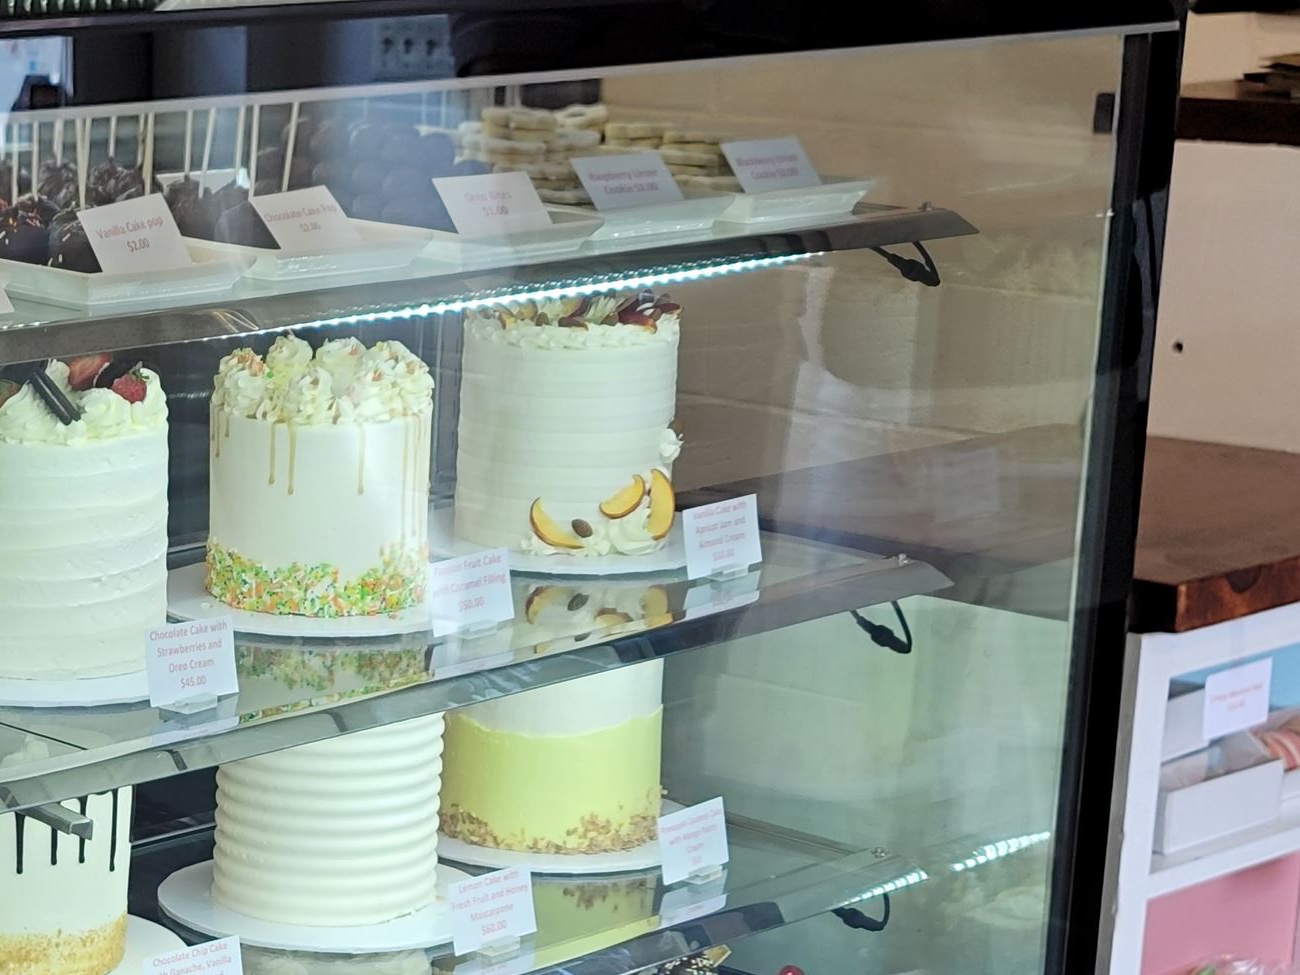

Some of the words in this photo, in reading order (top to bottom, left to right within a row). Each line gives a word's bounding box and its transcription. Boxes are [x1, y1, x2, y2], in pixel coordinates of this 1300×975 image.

[95, 224, 126, 239] Vanilla
[126, 220, 147, 233] Cake
[464, 559, 481, 569] Fruit
[483, 555, 501, 566] Cake
[451, 580, 482, 592] Caramel
[483, 573, 507, 584] Filling
[150, 628, 188, 640] Chocolate
[190, 624, 209, 635] Cake
[210, 620, 227, 631] with
[157, 642, 206, 657] Strawberries
[208, 638, 222, 649] and
[169, 663, 188, 673] Oreo
[189, 659, 214, 669] Cream
[180, 675, 206, 689] $45.00
[460, 881, 483, 894] Lemon
[484, 876, 501, 886] Cake
[503, 870, 519, 880] with
[451, 899, 471, 912] Fresh
[473, 893, 490, 904] Fruit
[491, 889, 504, 900] and
[506, 884, 529, 895] Honey
[470, 903, 514, 922] Mascarpone
[152, 951, 190, 968] Chocolate
[192, 947, 209, 958] Chip
[209, 942, 228, 953] Cake
[206, 956, 232, 968] Vanilla
